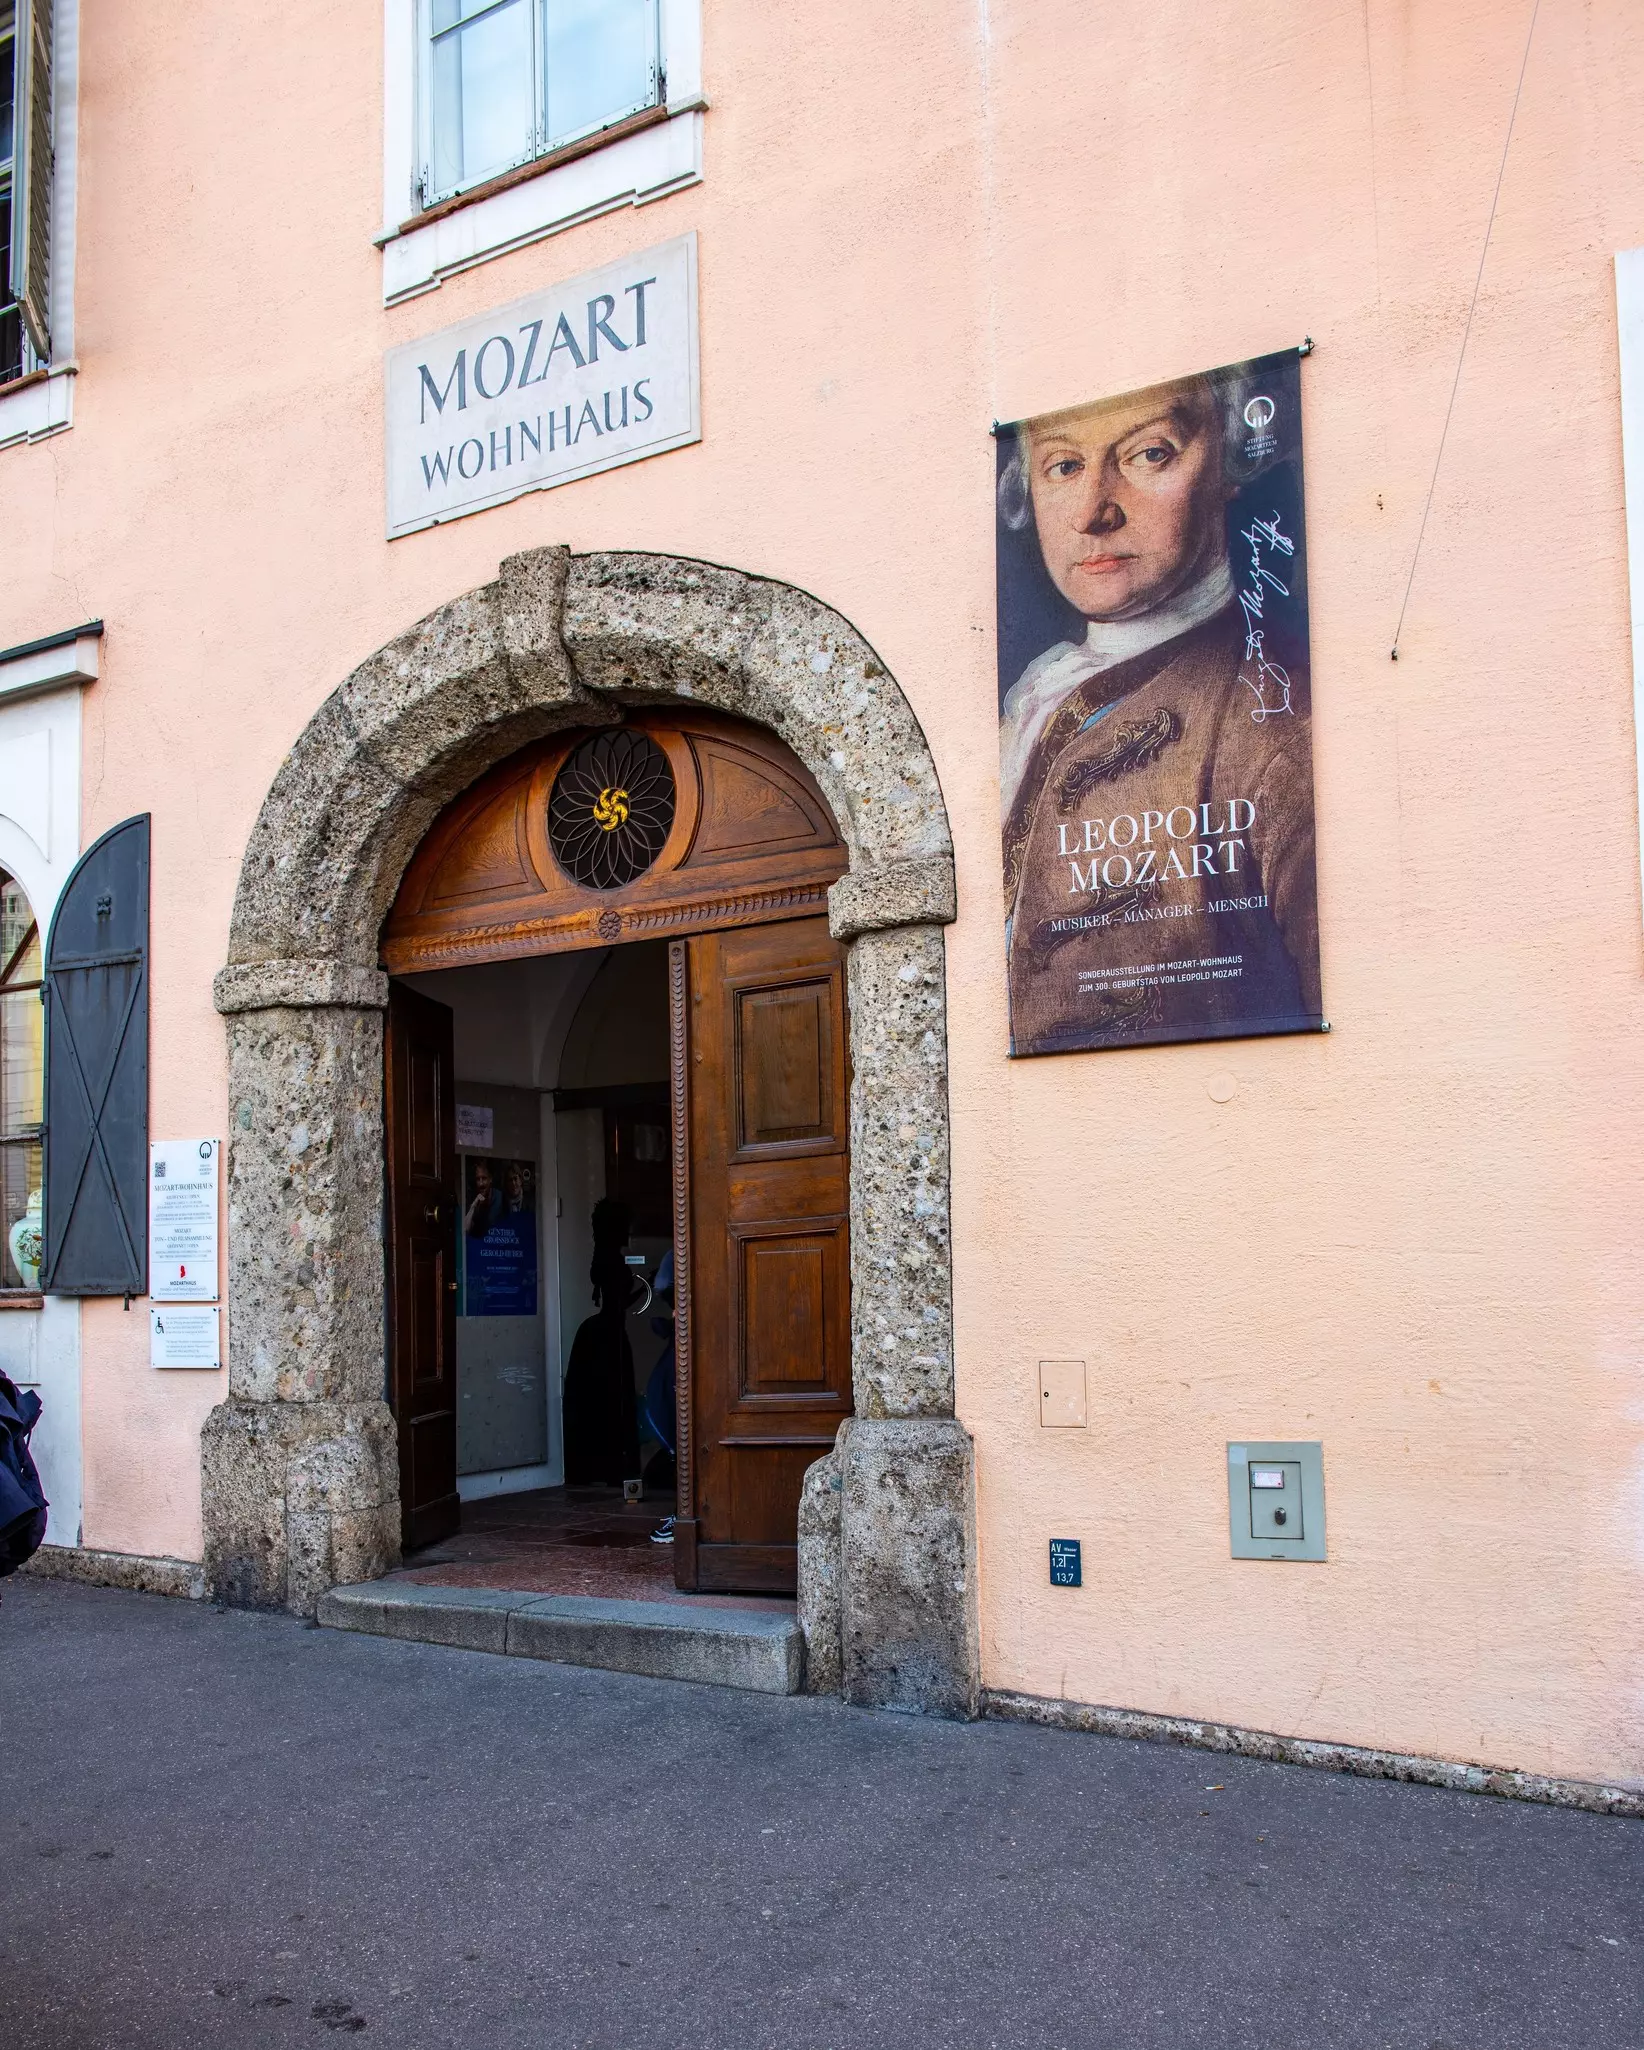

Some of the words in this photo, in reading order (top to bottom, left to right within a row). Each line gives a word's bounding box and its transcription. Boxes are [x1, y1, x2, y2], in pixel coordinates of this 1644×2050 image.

[417, 276, 657, 425] MOZART
[420, 377, 654, 492] WOHNHAUS
[1244, 439, 1278, 452] MOZARTEUM
[1246, 433, 1274, 444] STIFTUNG
[1247, 447, 1275, 459] SALZBURG
[1057, 798, 1256, 856] LEOPOLD
[1068, 838, 1246, 894] MOZART
[1050, 914, 1111, 933] MUSIKER
[1123, 903, 1193, 923] MANAGER
[1207, 895, 1269, 914] MENSCH
[1078, 963, 1155, 980] SONDERAUSSTELLUNG
[1156, 962, 1166, 972] IM
[1167, 955, 1243, 970] MOZART-WOHNHAUS
[1078, 983, 1093, 993] ZUM
[1095, 982, 1111, 991] 300.
[1112, 976, 1159, 989] GEBURTSTAG
[1160, 975, 1175, 984] VON
[1177, 971, 1210, 983] LEOPOLD
[1212, 968, 1243, 979] MOZART
[1051, 1542, 1062, 1553] AV
[1051, 1557, 1064, 1568] 1,2
[1056, 1572, 1074, 1584] 13,7
